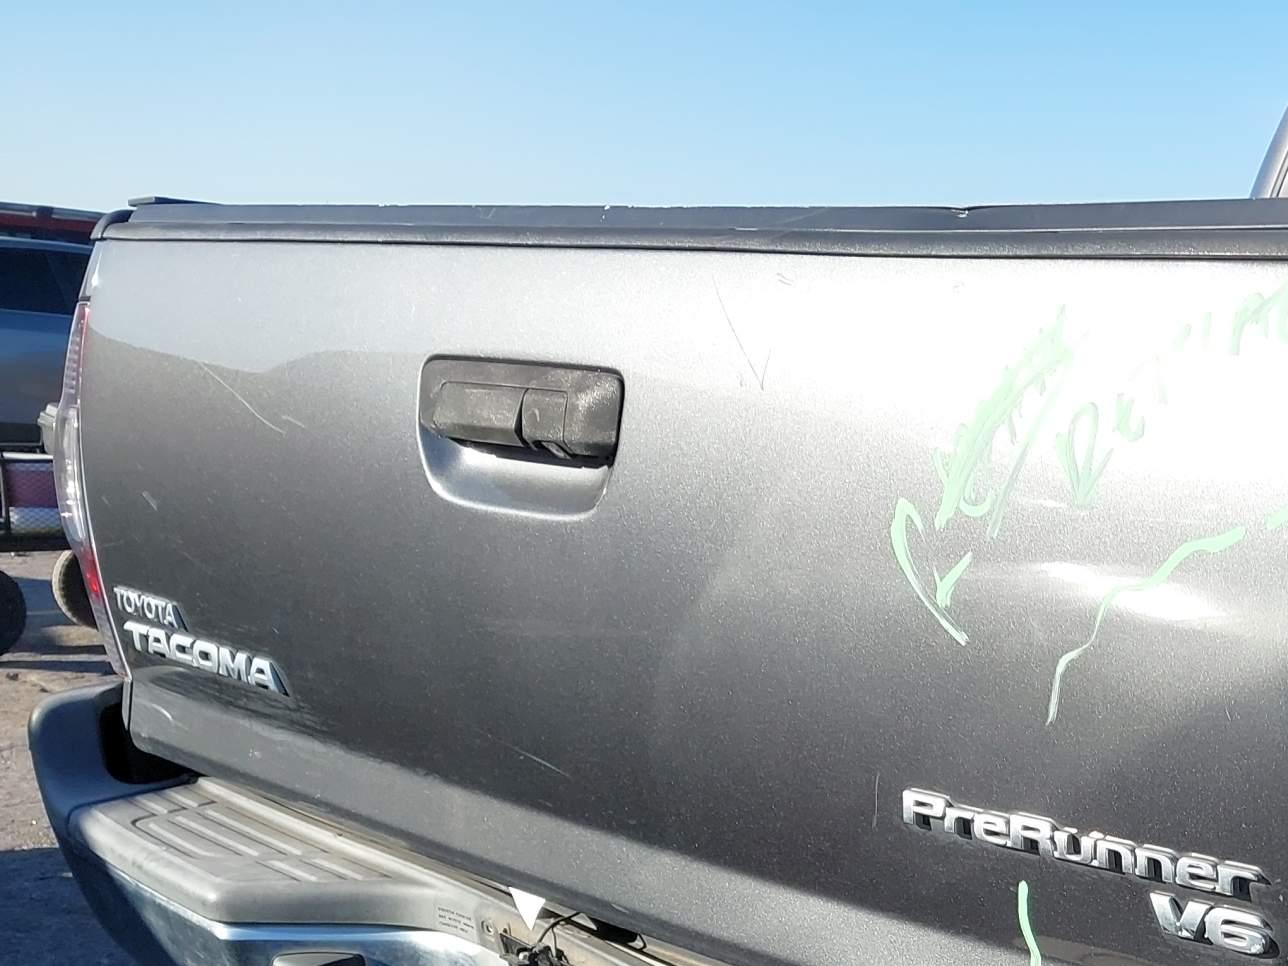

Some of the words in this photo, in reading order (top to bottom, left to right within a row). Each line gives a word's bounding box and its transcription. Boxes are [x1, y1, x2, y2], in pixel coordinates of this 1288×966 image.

[113, 585, 188, 632] TOYOTA
[123, 620, 290, 697] TACOMA
[902, 788, 1272, 900] PreRunner
[1149, 890, 1280, 959] V6
